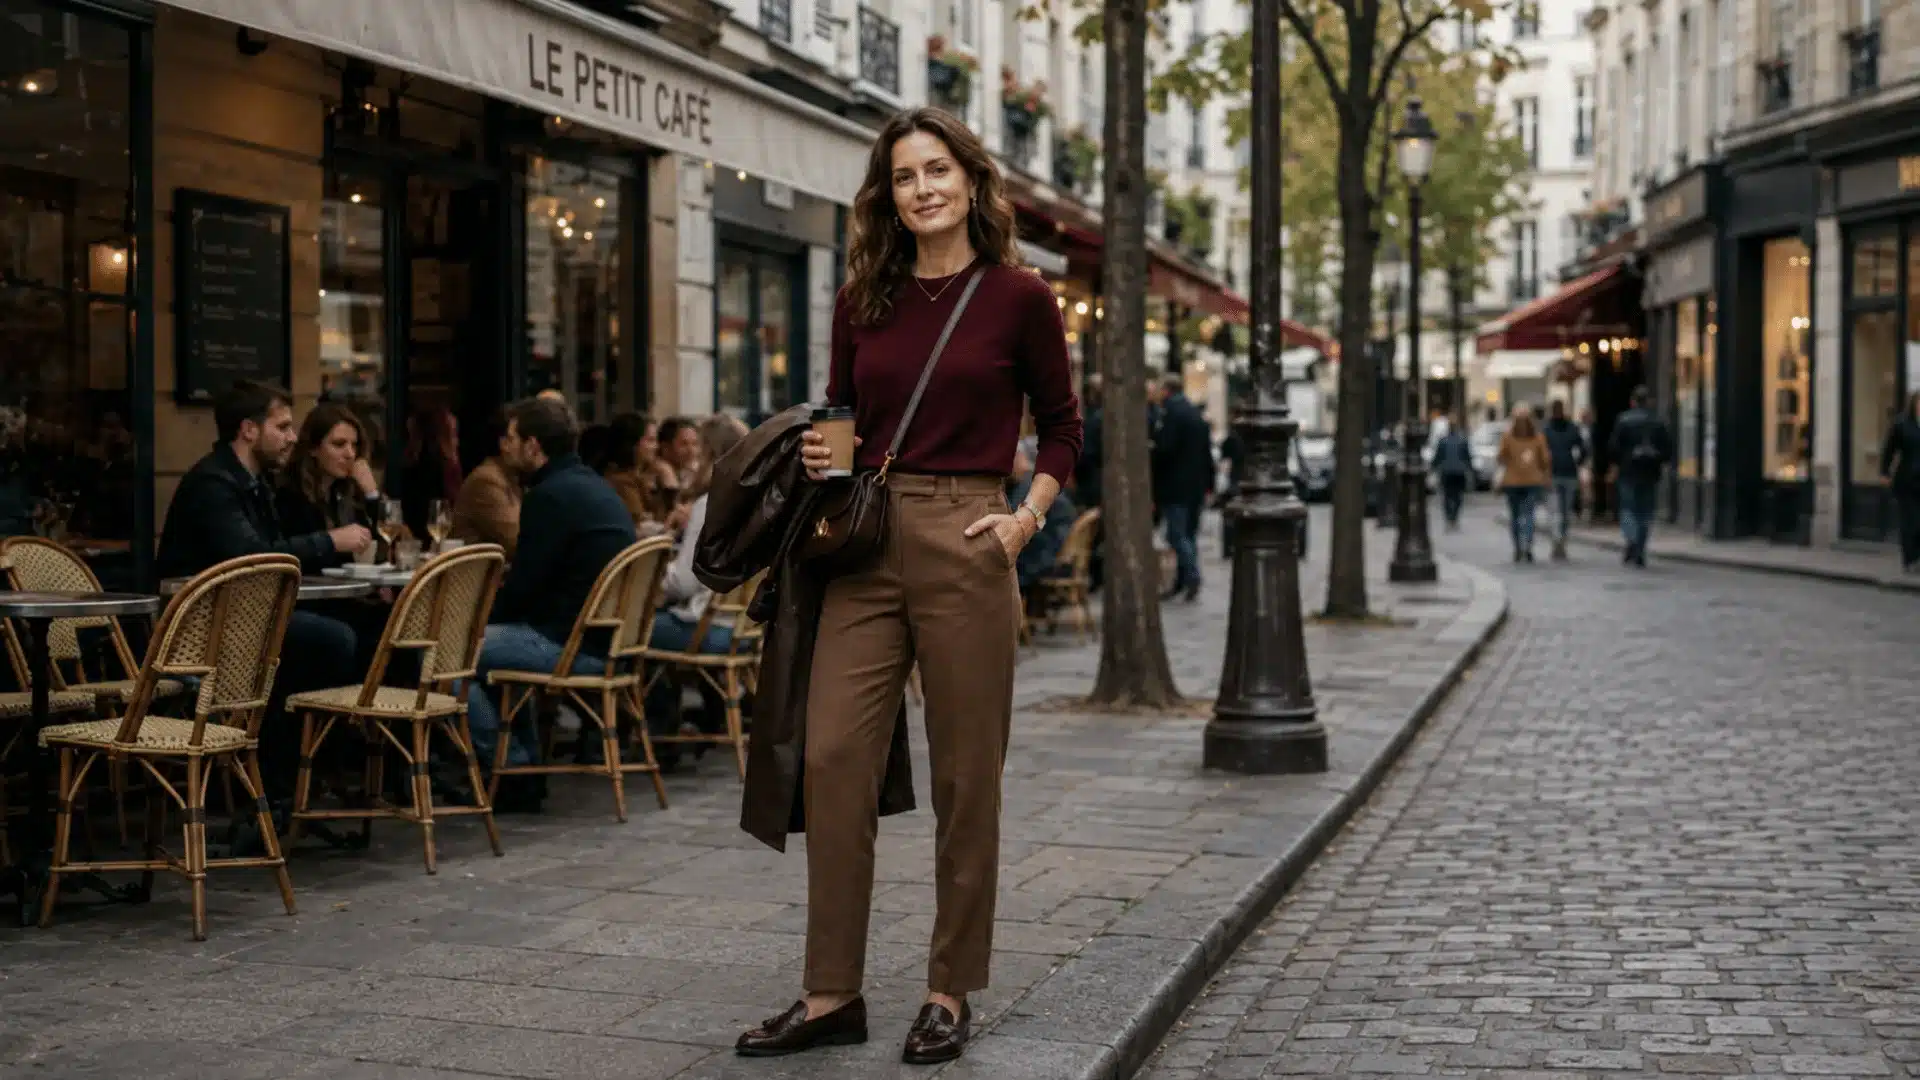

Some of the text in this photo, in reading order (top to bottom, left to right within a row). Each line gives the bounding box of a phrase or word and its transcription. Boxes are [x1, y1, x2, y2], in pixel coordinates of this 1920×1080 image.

[528, 33, 712, 146] LE PETIT CAFÉ
